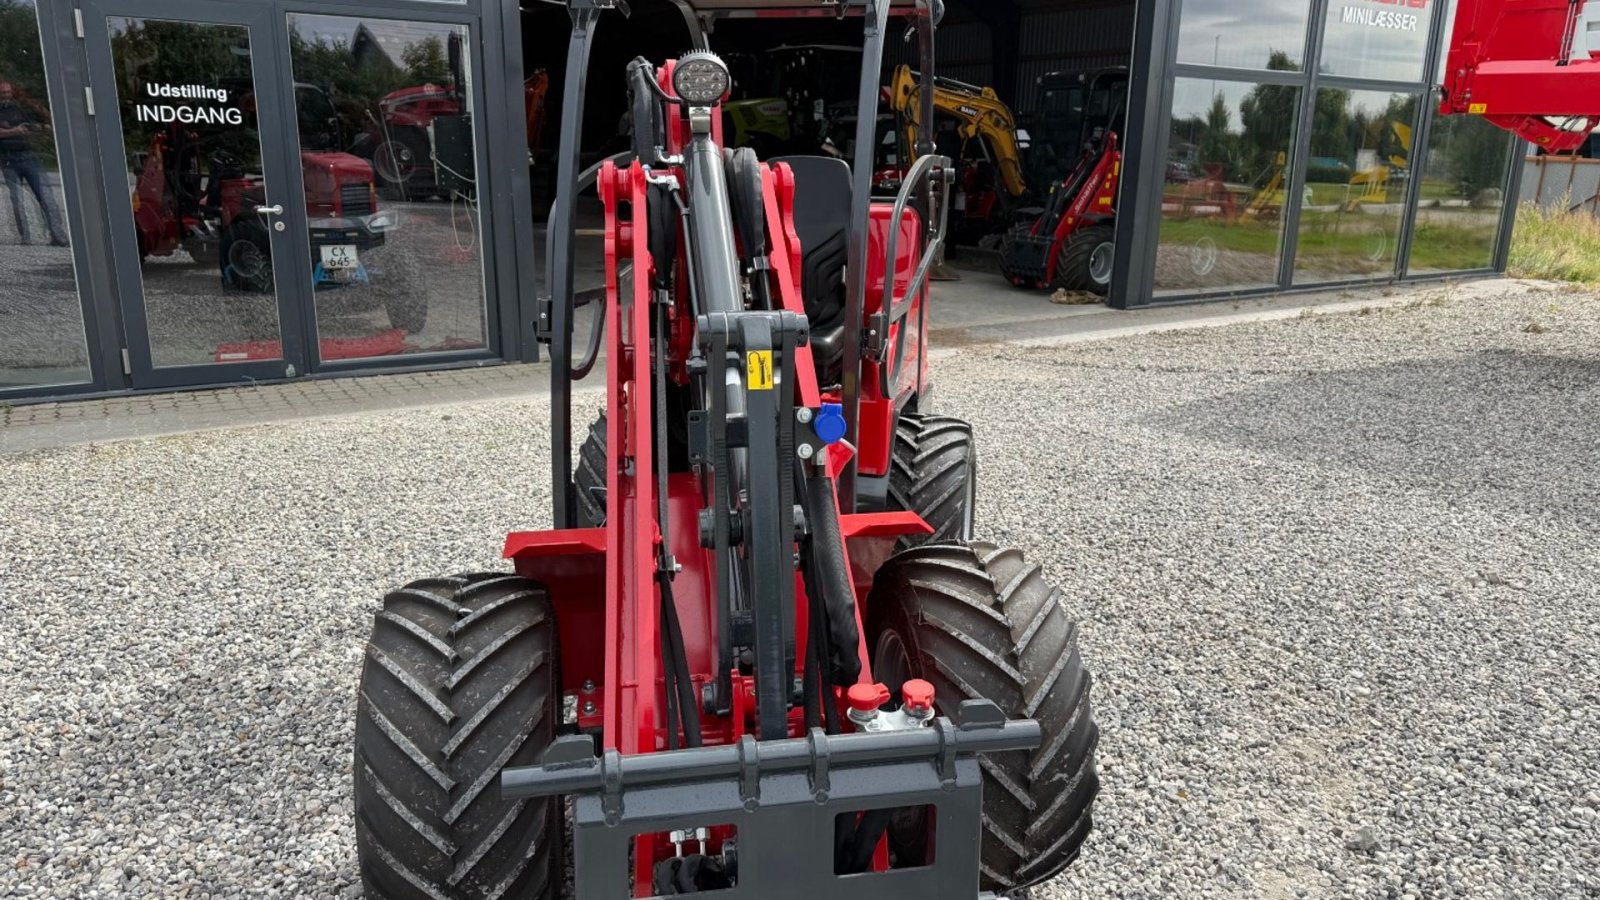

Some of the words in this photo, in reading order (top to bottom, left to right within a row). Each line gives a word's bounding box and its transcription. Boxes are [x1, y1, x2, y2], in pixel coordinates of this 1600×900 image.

[1343, 6, 1417, 31] MINILÆSSER
[146, 82, 228, 103] Udstilling
[136, 104, 243, 125] INDGANG
[329, 256, 350, 267] 645
[331, 246, 347, 257] CX
